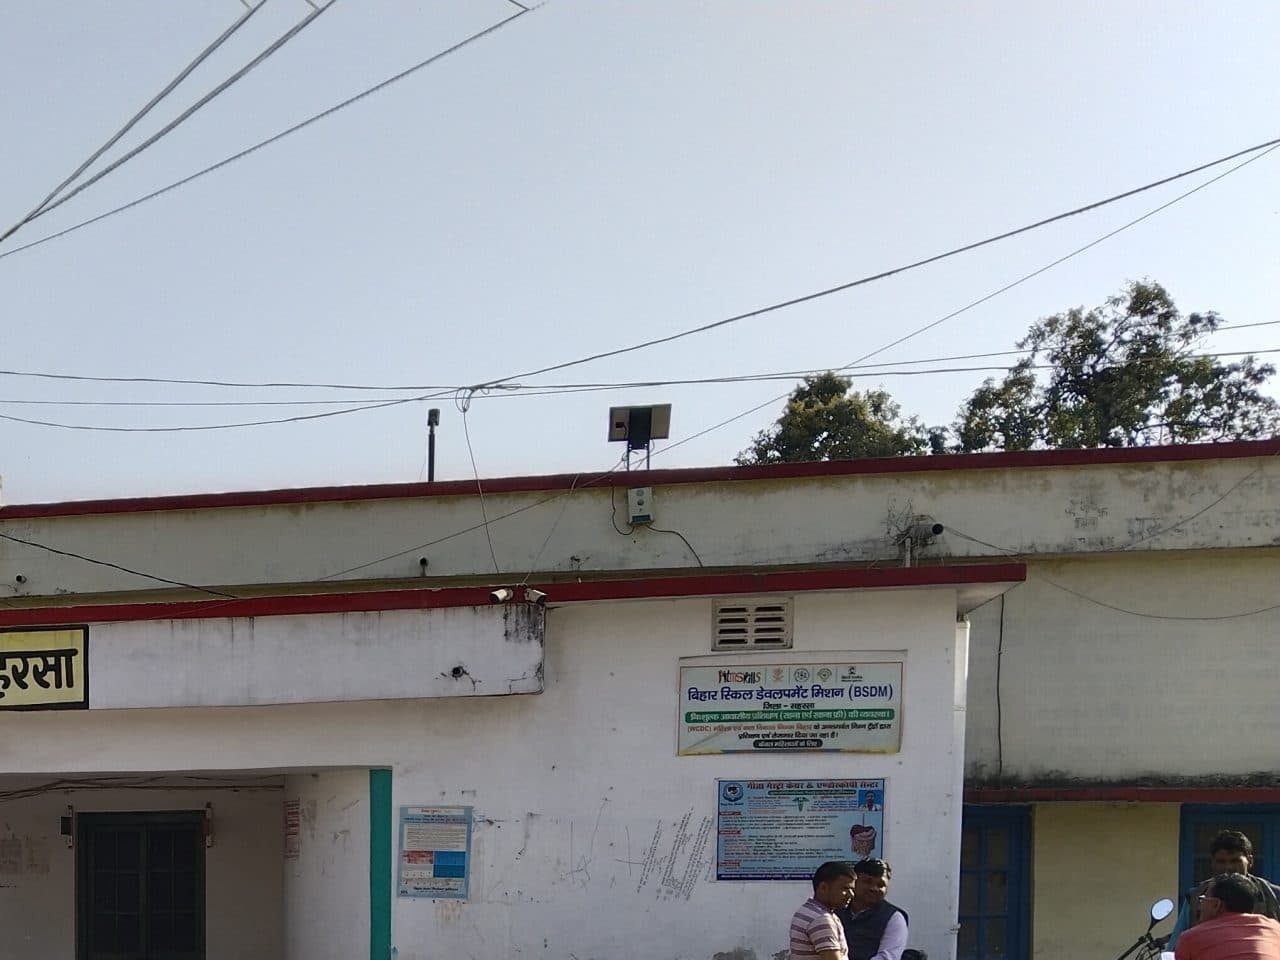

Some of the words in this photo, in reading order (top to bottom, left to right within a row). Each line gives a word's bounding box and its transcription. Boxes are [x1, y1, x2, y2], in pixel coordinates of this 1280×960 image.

[688, 687, 718, 701] बिहार
[720, 687, 754, 700] स्किल
[756, 685, 808, 700] डेवलपमेंट
[811, 685, 844, 699] मिशन
[848, 684, 893, 701] (BSDM)
